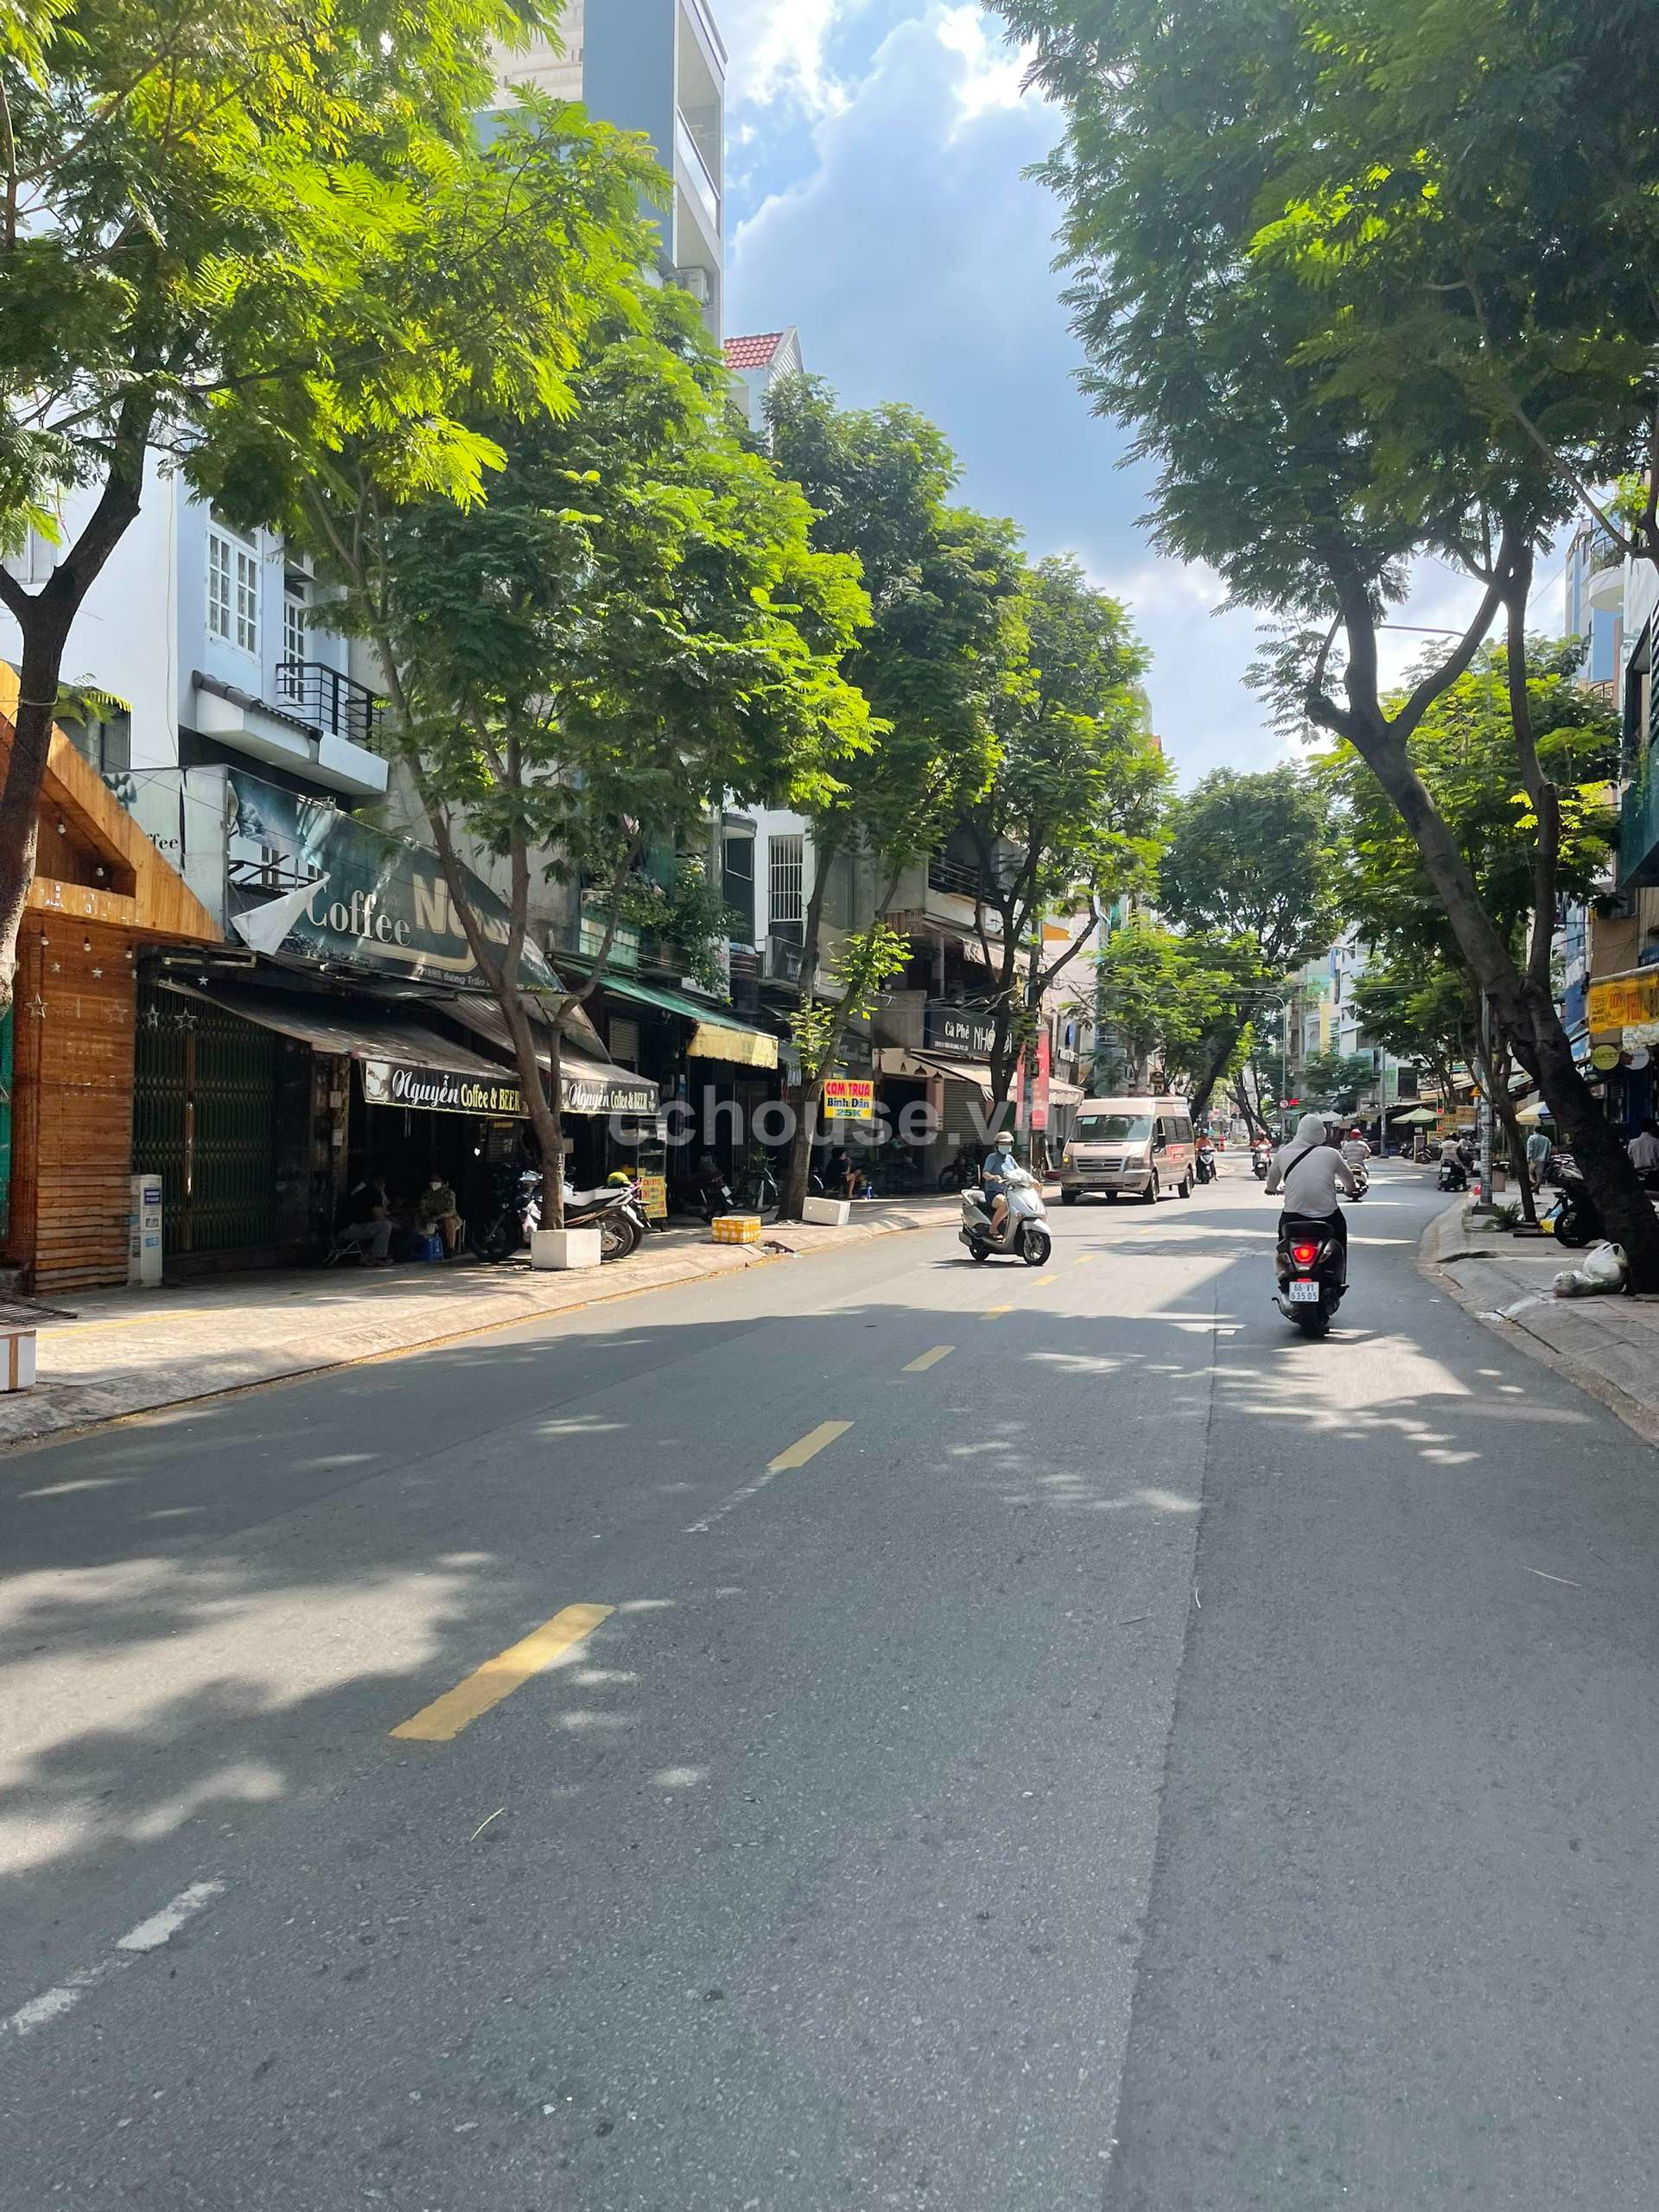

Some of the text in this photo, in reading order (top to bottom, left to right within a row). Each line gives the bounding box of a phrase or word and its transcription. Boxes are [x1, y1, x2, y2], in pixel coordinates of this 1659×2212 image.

[305, 882, 411, 946] Coffee
[392, 1069, 460, 1107] Nguyễn
[461, 1084, 488, 1109] Coffee
[490, 1087, 497, 1109] &
